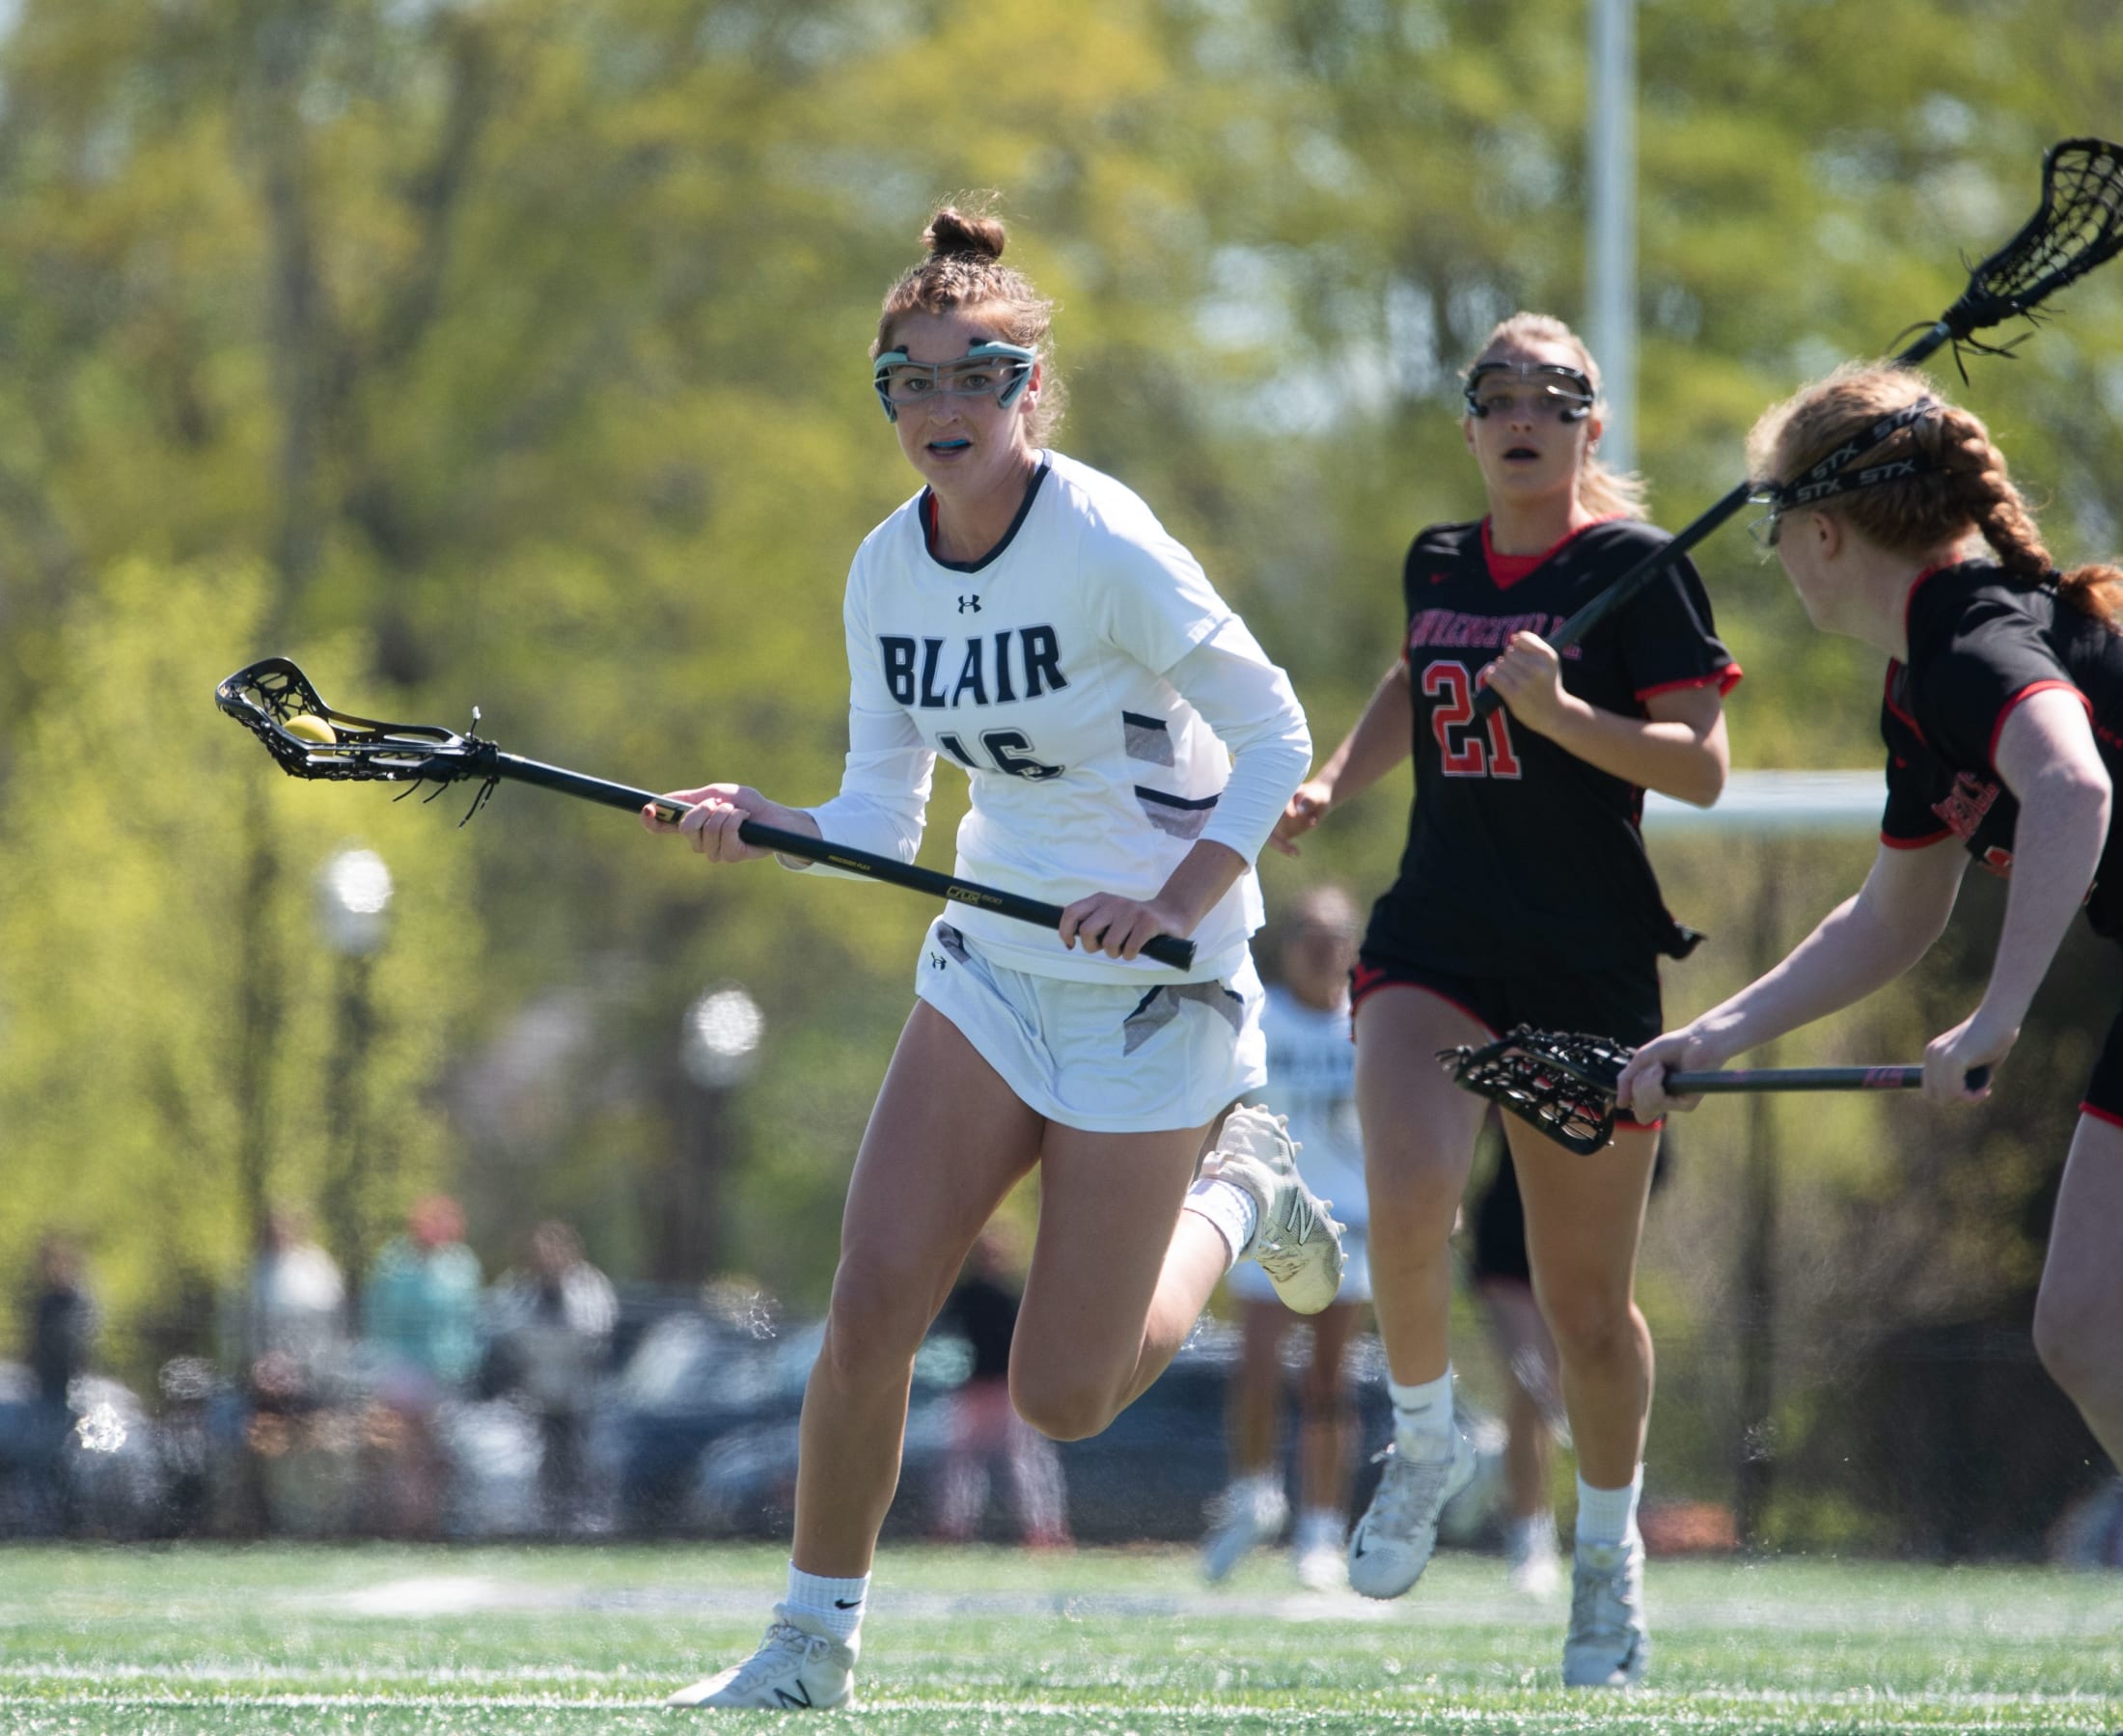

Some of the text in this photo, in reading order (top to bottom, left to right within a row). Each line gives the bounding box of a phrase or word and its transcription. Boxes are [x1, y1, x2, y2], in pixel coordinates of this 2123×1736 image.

[1811, 440, 1860, 481] STX
[1859, 458, 1916, 484] STX
[1797, 478, 1842, 504] STX
[876, 622, 1070, 709] BLAIR
[1421, 659, 1522, 780] 21
[933, 727, 1065, 781] 16
